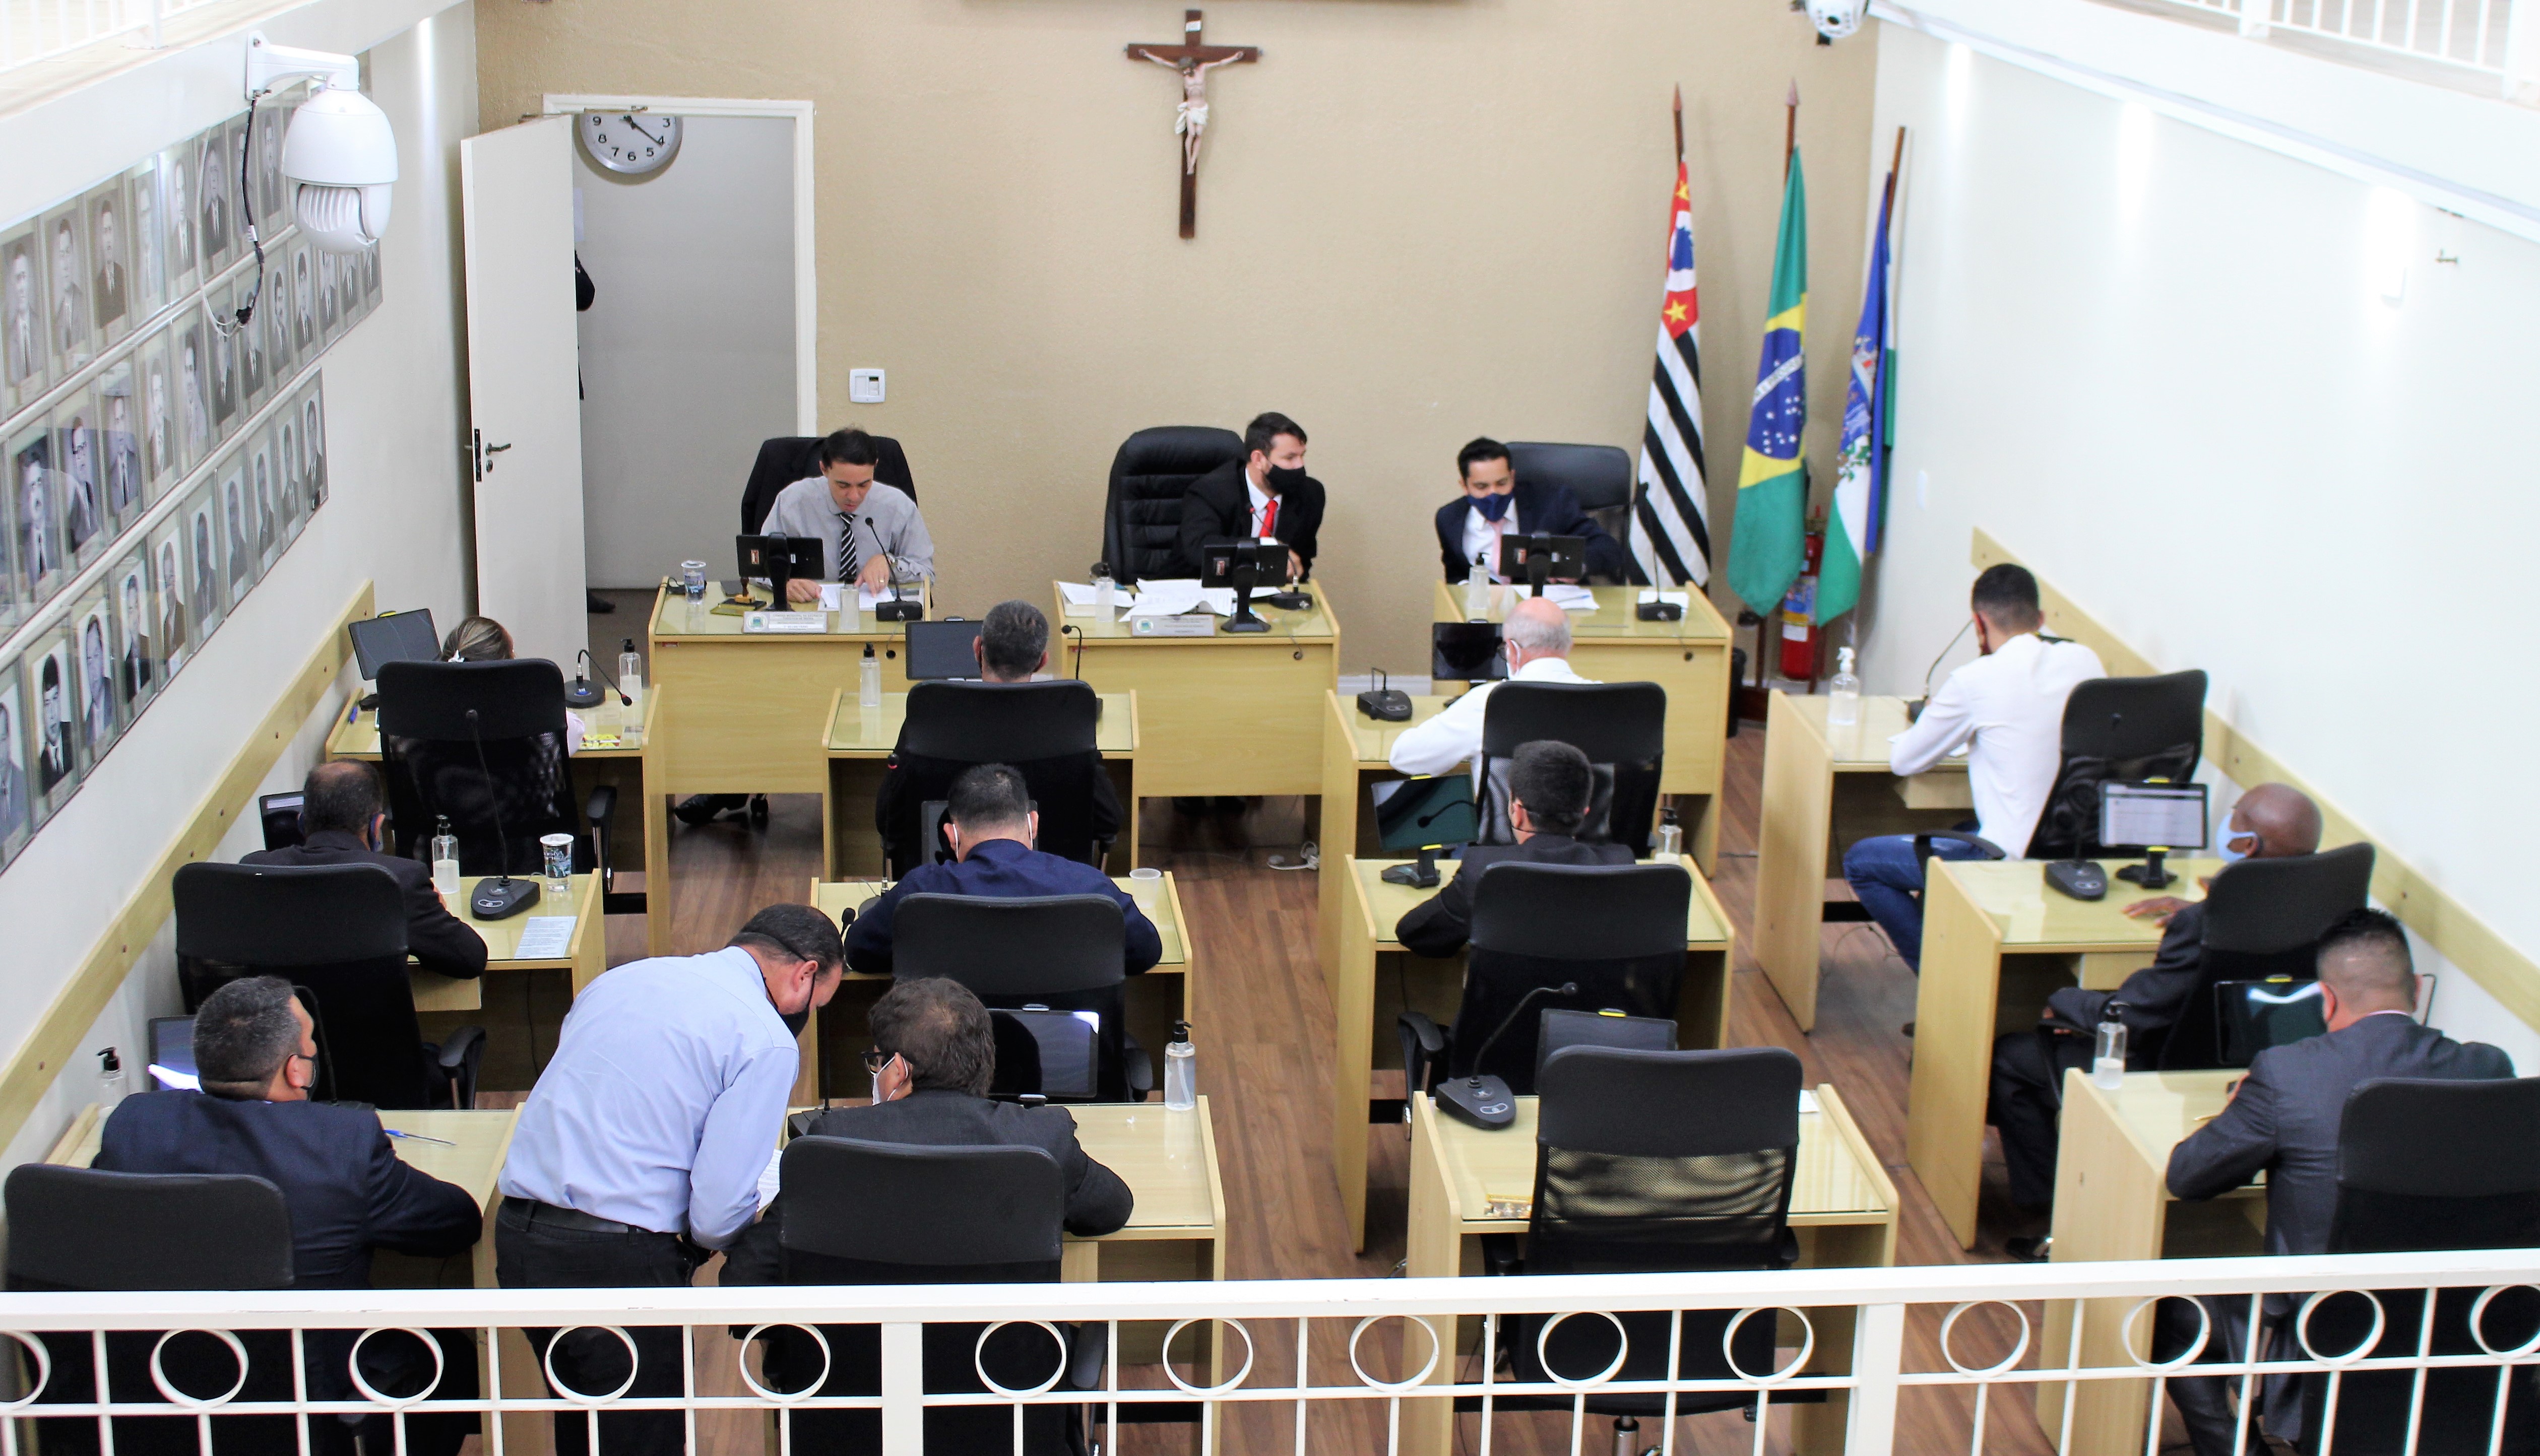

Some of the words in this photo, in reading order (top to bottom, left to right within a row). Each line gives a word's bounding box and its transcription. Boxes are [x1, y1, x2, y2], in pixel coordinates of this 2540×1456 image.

[593, 116, 601, 125] 9
[663, 118, 670, 127] 3
[598, 134, 607, 143] 8
[657, 135, 664, 146] 4
[611, 147, 619, 157] 7
[627, 152, 636, 161] 6
[646, 147, 654, 157] 5
